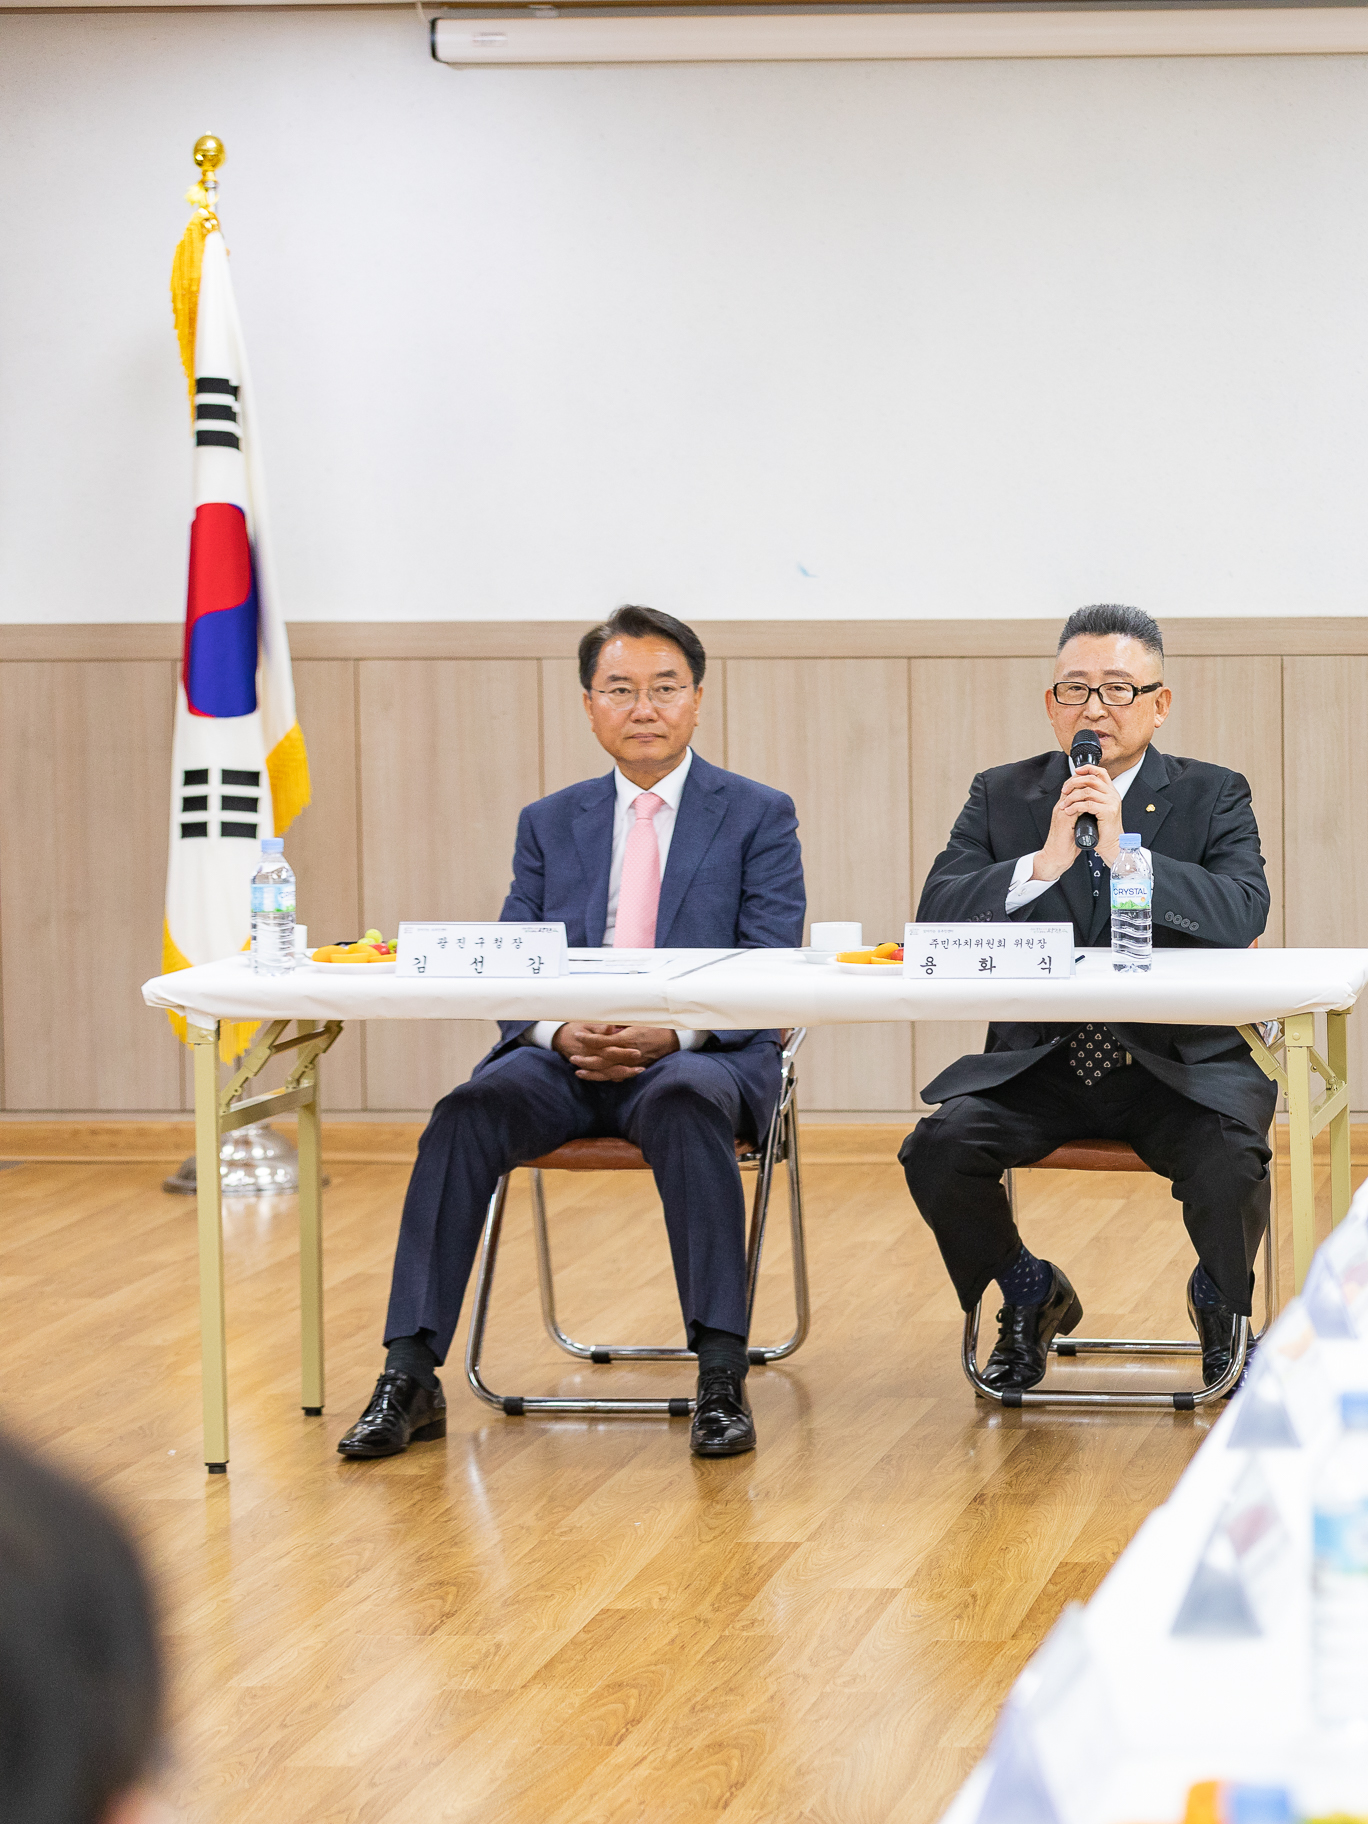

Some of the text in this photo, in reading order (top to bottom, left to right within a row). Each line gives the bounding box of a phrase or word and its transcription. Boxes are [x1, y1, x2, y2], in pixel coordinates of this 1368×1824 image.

[1113, 887, 1148, 896] CRYSTAL
[929, 938, 1047, 950] 주민자치위원회 위원장
[920, 956, 1052, 975] 용 화 식
